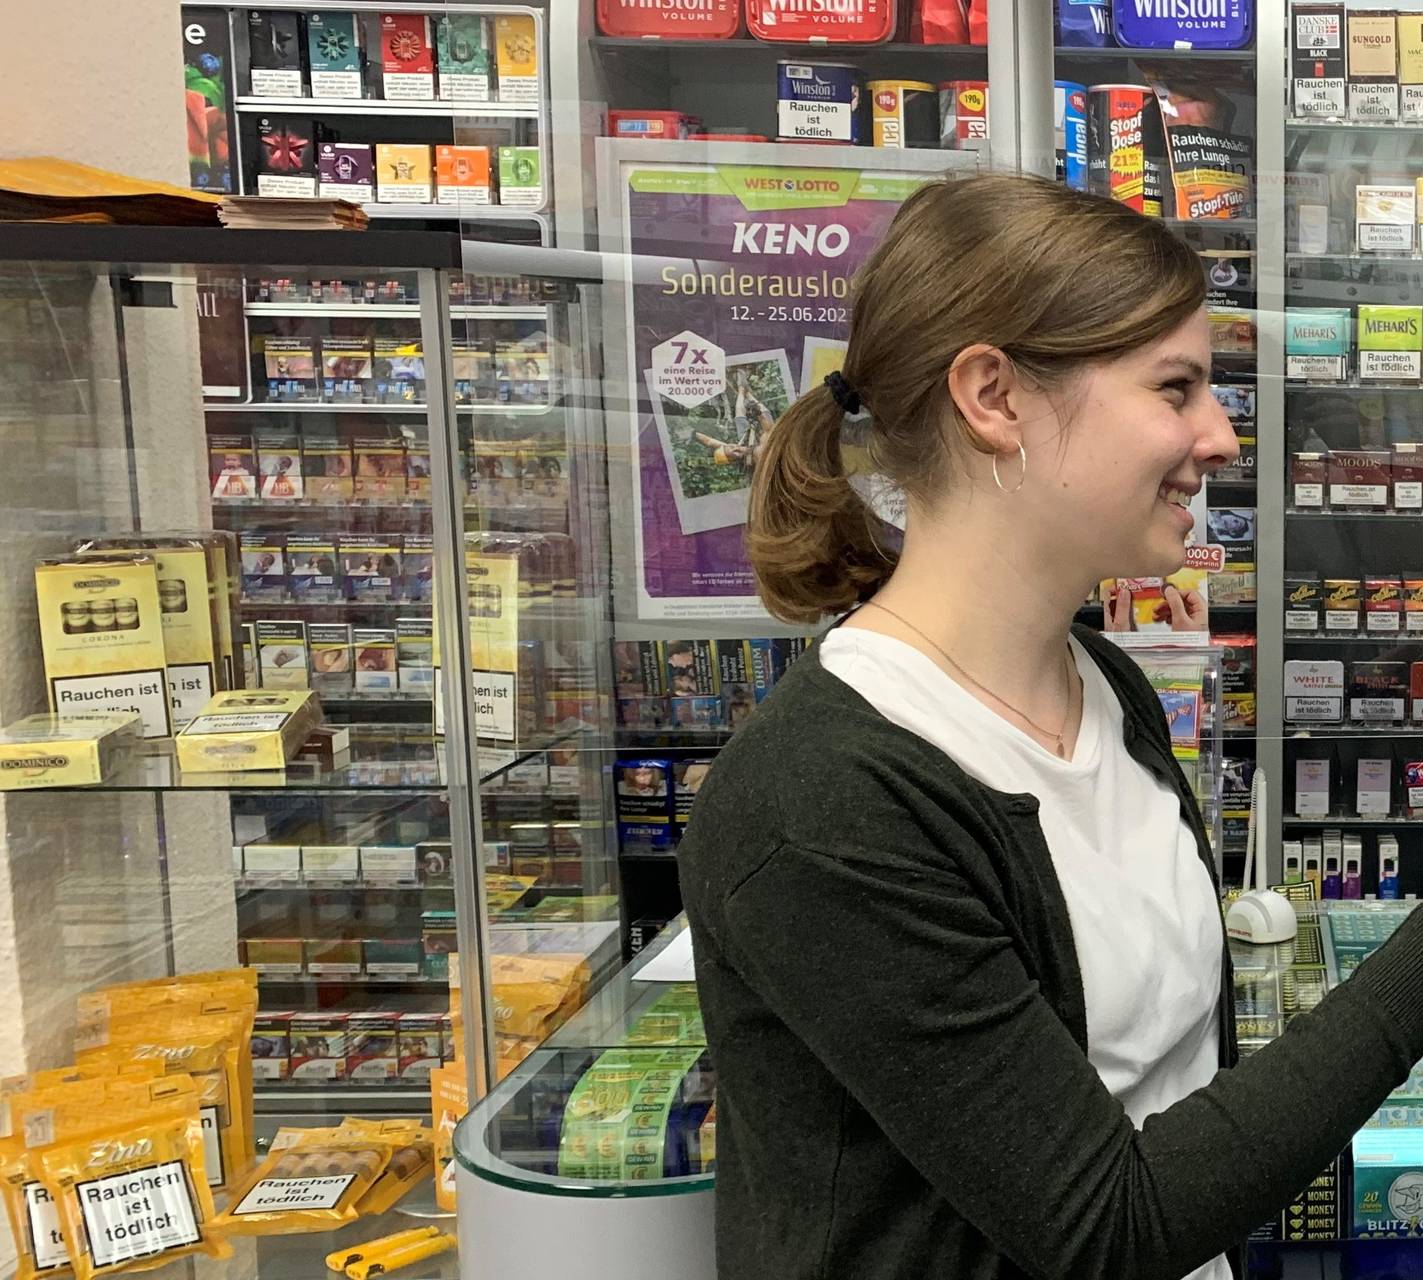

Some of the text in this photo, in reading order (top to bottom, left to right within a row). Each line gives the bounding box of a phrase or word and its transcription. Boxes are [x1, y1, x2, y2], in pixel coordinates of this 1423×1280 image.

[662, 12, 713, 21] VOLUME
[812, 15, 864, 23] VOLUME
[1298, 17, 1338, 26] DANSKE
[1177, 21, 1226, 29] VOLUME
[1298, 25, 1326, 34] CLUB
[184, 24, 206, 45] e
[1352, 35, 1392, 44] SUNGOLD
[1309, 49, 1328, 58] BLACK
[792, 80, 832, 97] Winston
[1297, 79, 1343, 90] Rauchen
[1351, 84, 1395, 95] Rauchen
[964, 94, 981, 105] 190g
[1313, 91, 1326, 100] ist
[1367, 95, 1379, 104] ist
[789, 101, 838, 113] Rauchen
[1302, 101, 1338, 112] tödlich
[1356, 105, 1390, 115] tödlich
[807, 115, 821, 124] ist
[1110, 112, 1143, 136] Stopf
[795, 126, 832, 137] tödlich
[1067, 116, 1087, 165] ducal
[1111, 130, 1142, 149] Dose
[1171, 133, 1219, 147] Rauchen
[1174, 149, 1230, 165] Ihre Lunge
[745, 178, 840, 192] WEST LOTTO
[732, 222, 850, 258] KENO
[661, 266, 847, 298] Sonderauslo
[768, 307, 853, 323] 25.06.202
[1364, 318, 1418, 336] MEHARI'S
[1292, 326, 1337, 341] MEHARI'S
[671, 341, 709, 365] 7x
[1367, 353, 1411, 363] Rauchen
[688, 367, 716, 375] Reise
[1381, 363, 1415, 372] tödlich
[659, 376, 722, 386] im Wert von
[1336, 458, 1382, 468] MOODS
[1211, 550, 1220, 561] €
[181, 679, 202, 690] ist
[1292, 676, 1335, 684] WHITE
[61, 682, 159, 703] Rauchen ist
[1, 757, 67, 768] DOMINICO
[201, 1117, 212, 1130] n
[86, 1137, 153, 1168] Zino
[86, 1172, 181, 1205] Rauchen
[259, 1176, 347, 1190] Rauchen
[285, 1186, 310, 1196] ist
[1307, 1191, 1335, 1202] MONEY
[257, 1193, 325, 1205] tödlich
[126, 1199, 152, 1216] ist
[1307, 1205, 1335, 1216] MONEY
[106, 1214, 179, 1243] tödlich
[1307, 1218, 1335, 1229] MONEY
[1367, 1220, 1409, 1231] BLITZ
